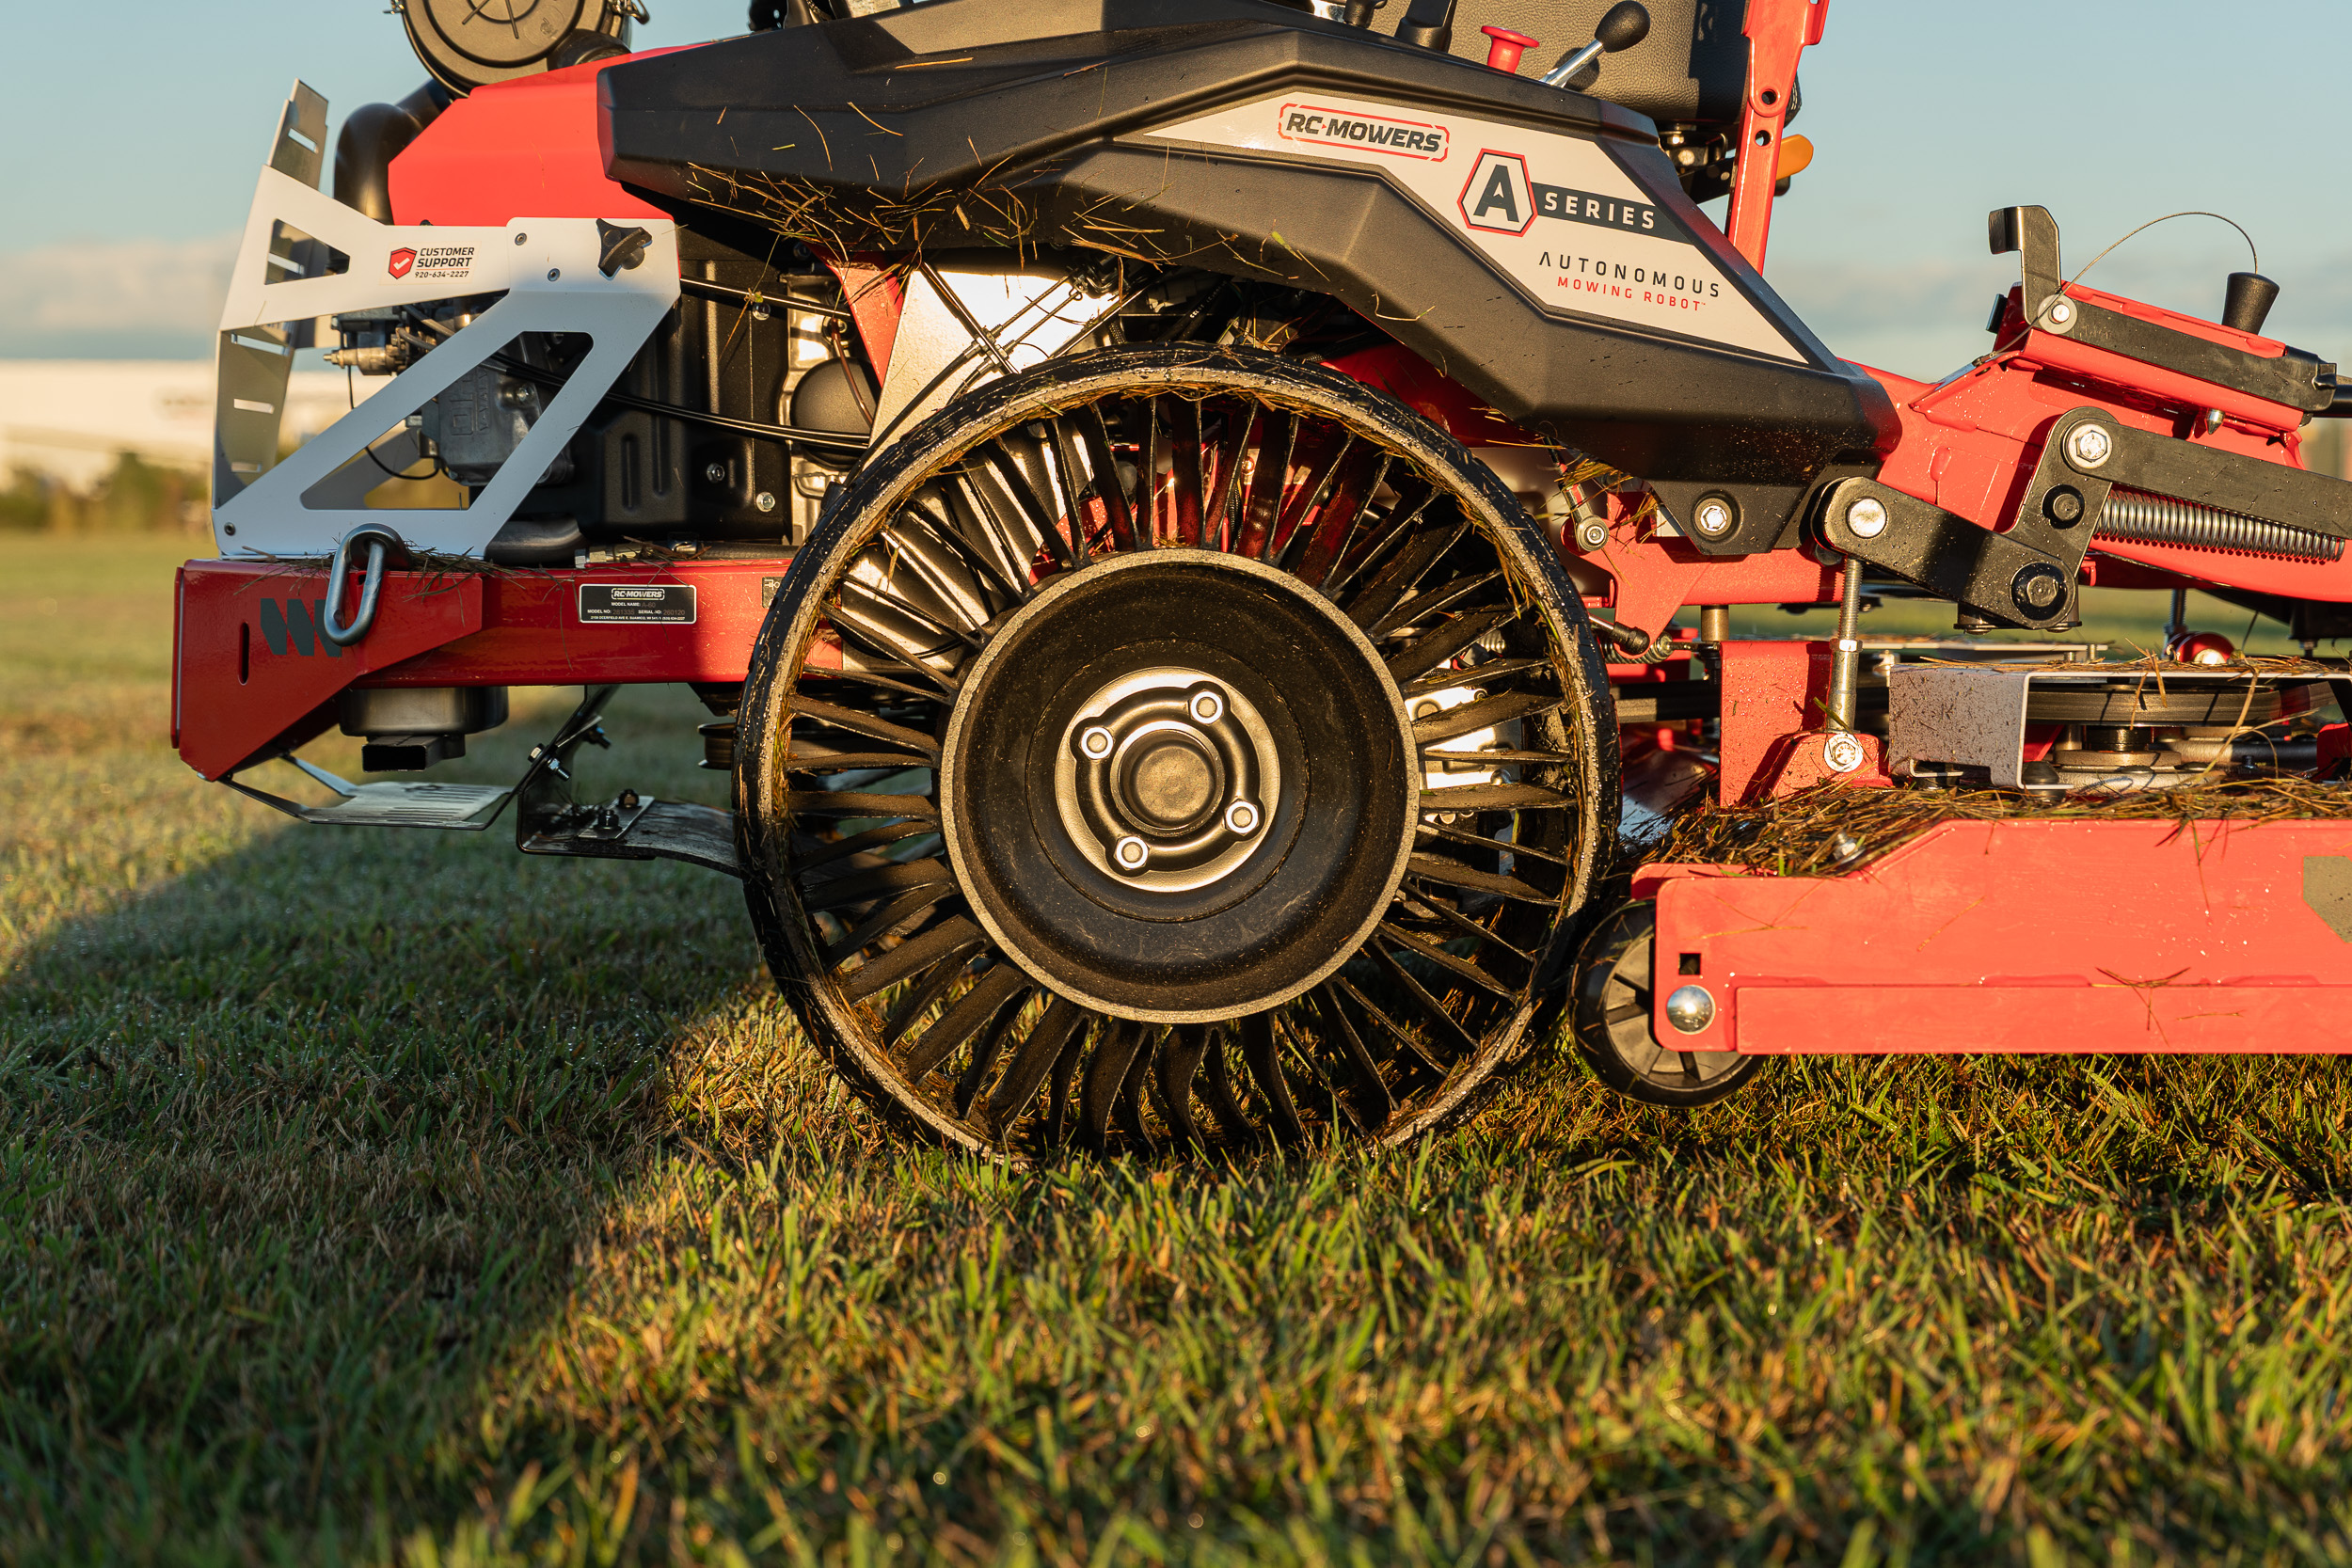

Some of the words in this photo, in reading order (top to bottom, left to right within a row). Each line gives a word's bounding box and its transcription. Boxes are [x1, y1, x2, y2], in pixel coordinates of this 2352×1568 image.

[1473, 164, 1520, 223] A
[1544, 192, 1655, 230] SERIES
[420, 246, 475, 257] CUSTOMER
[417, 257, 472, 268] SUPPORT
[415, 270, 469, 278] 920-634-2227
[1539, 251, 1719, 297] AUTONOMOUS
[1557, 277, 1632, 299] MOWING
